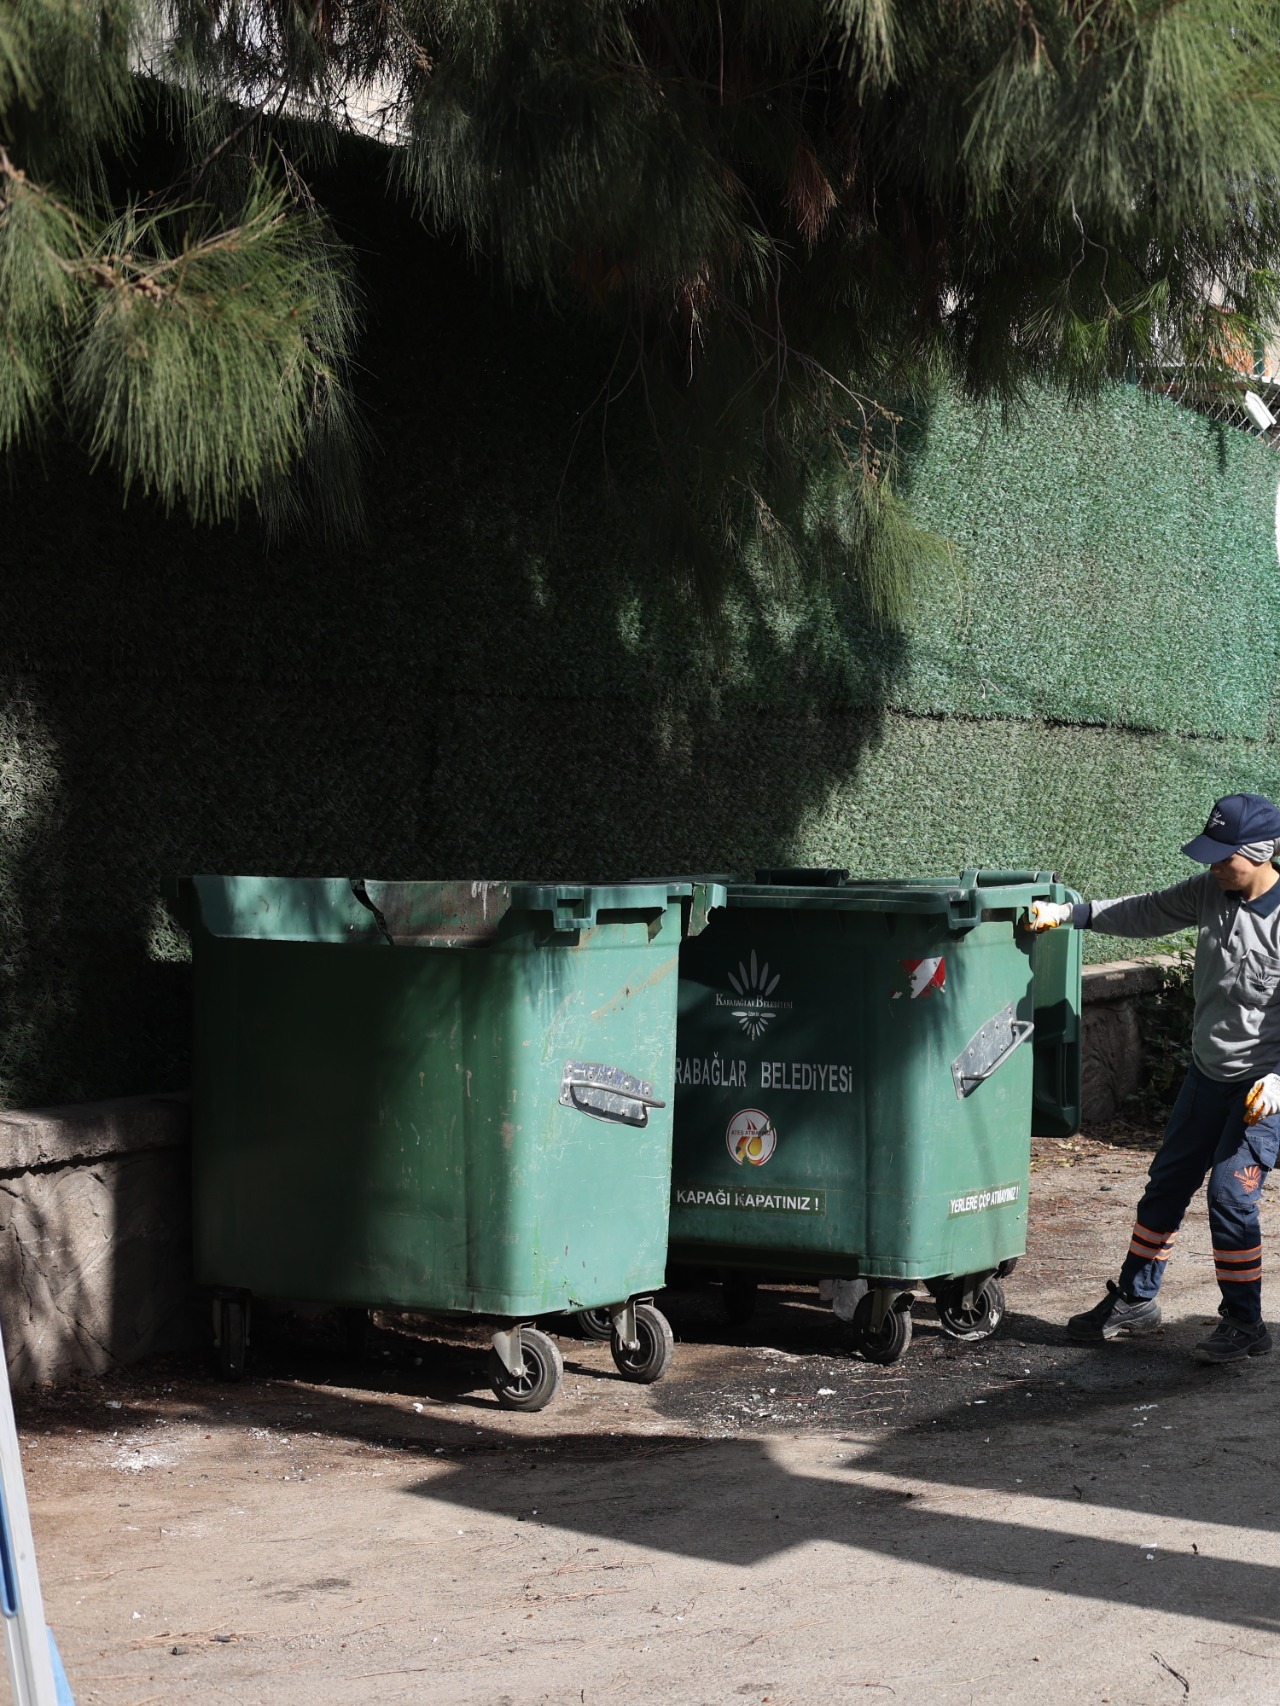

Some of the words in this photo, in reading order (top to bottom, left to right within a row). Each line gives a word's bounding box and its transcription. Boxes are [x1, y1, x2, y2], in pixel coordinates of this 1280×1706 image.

[675, 1051, 747, 1087] RABAĞLAR
[676, 1189, 730, 1206] KAPAĞI
[735, 1192, 811, 1211] KAPATINIZ
[950, 1195, 978, 1213] YERLERE
[978, 1190, 991, 1211] ÇÖP
